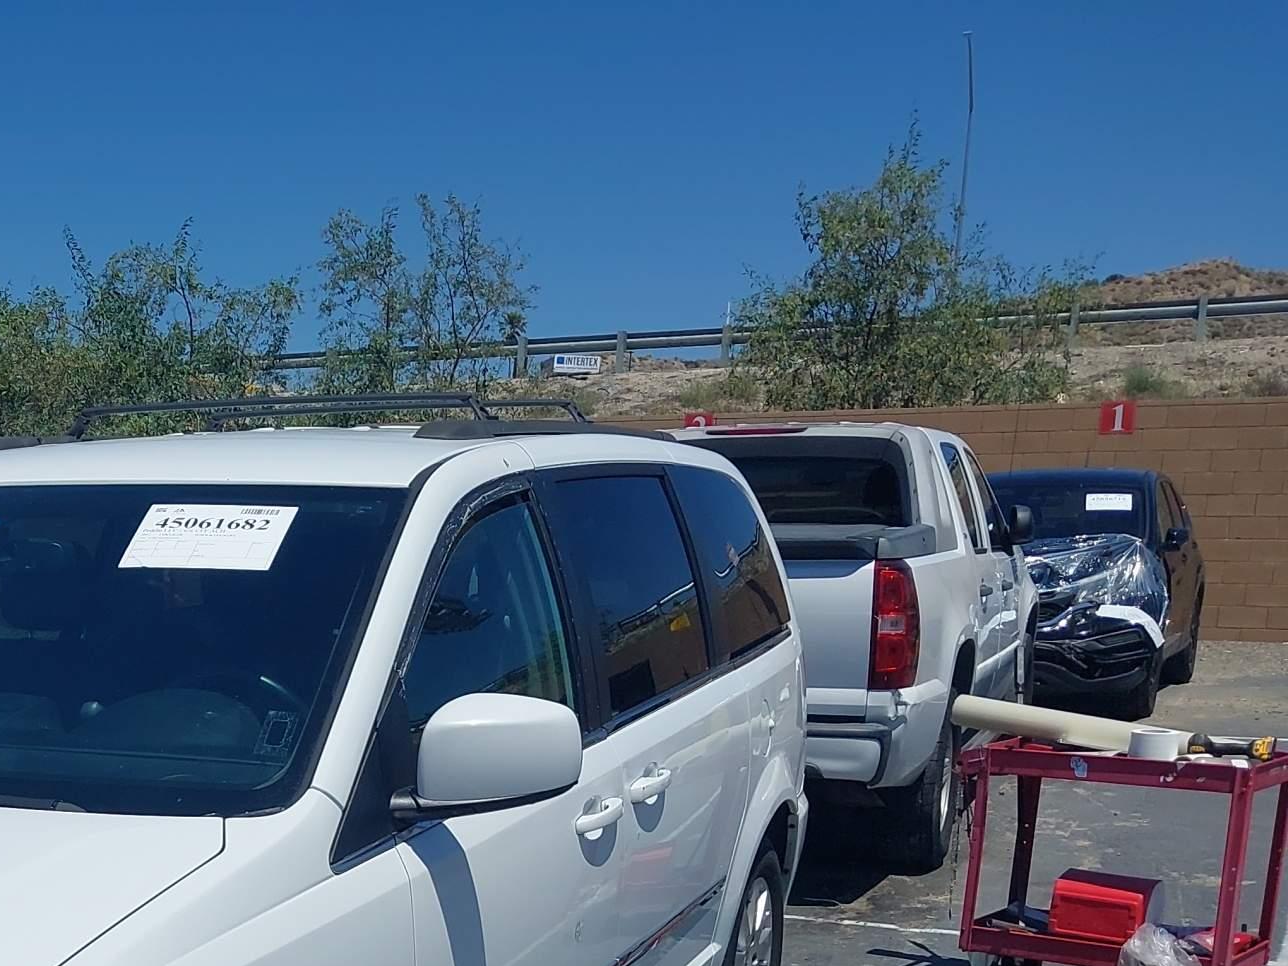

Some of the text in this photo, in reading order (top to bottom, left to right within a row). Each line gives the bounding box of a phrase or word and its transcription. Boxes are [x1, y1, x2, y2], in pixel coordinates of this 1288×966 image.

[565, 356, 599, 368] INTERTEX
[1111, 404, 1125, 432] 1
[155, 517, 271, 531] 45061682
